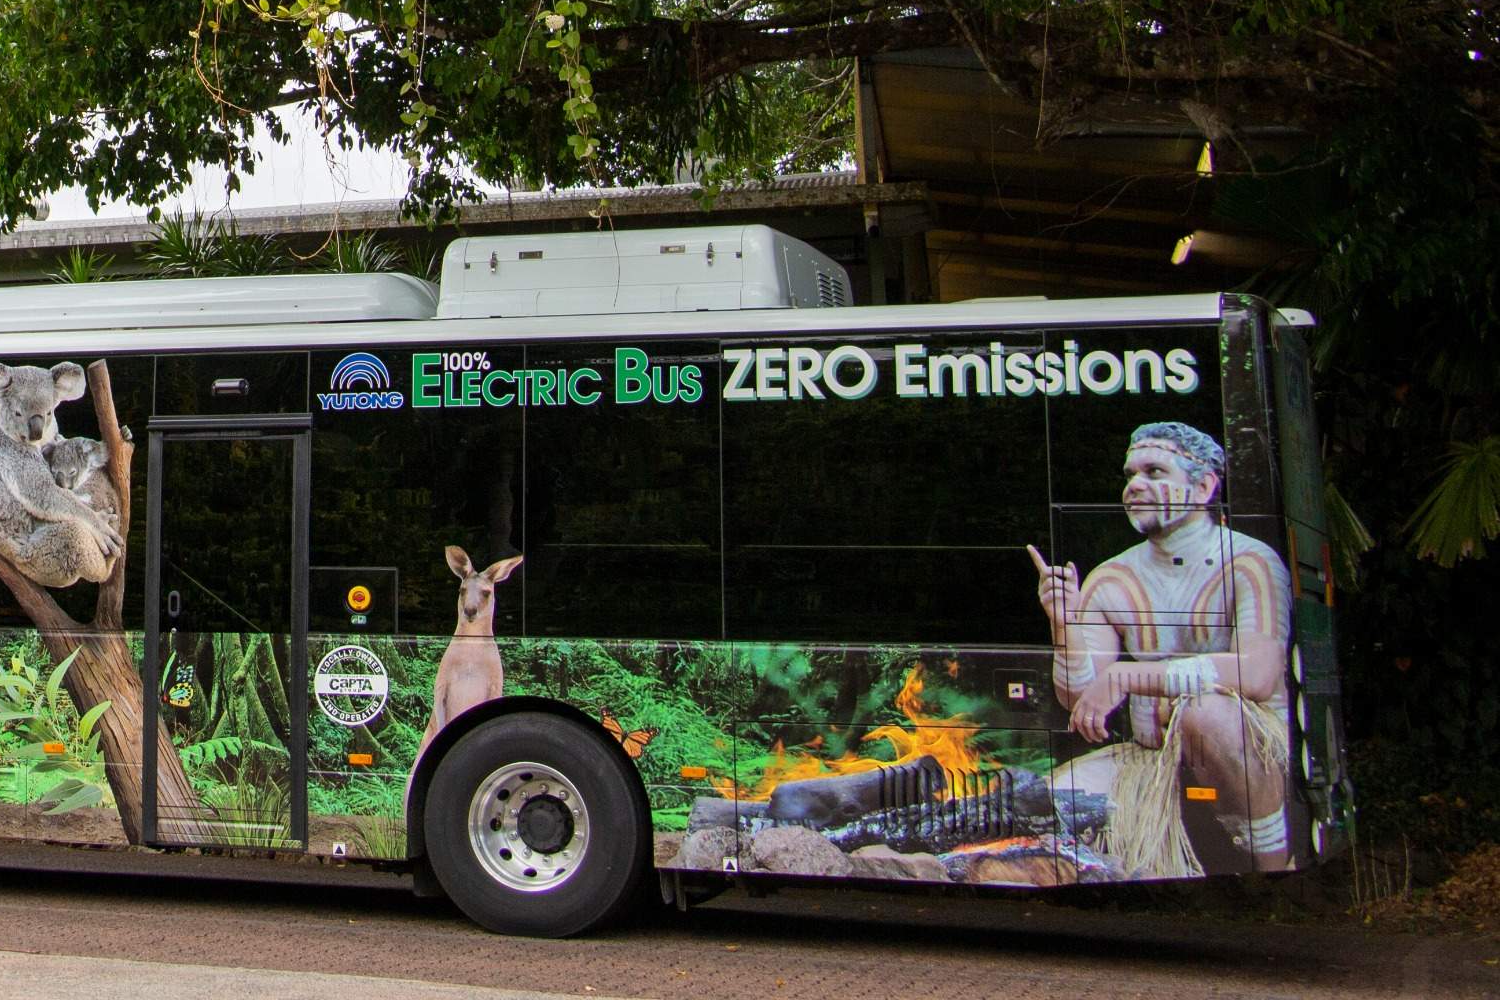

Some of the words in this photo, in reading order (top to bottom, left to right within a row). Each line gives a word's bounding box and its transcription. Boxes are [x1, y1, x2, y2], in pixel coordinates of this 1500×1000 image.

[442, 352, 491, 371] 100%
[722, 345, 878, 400] ZERO
[894, 339, 1200, 397] Emissions
[411, 353, 602, 408] ELECTRIC
[615, 347, 703, 404] BUS
[317, 392, 404, 410] YUTONG
[320, 649, 353, 673] LOCALLY
[355, 650, 381, 673] OWNED
[323, 700, 339, 716] AND
[339, 702, 380, 722] OPERATED
